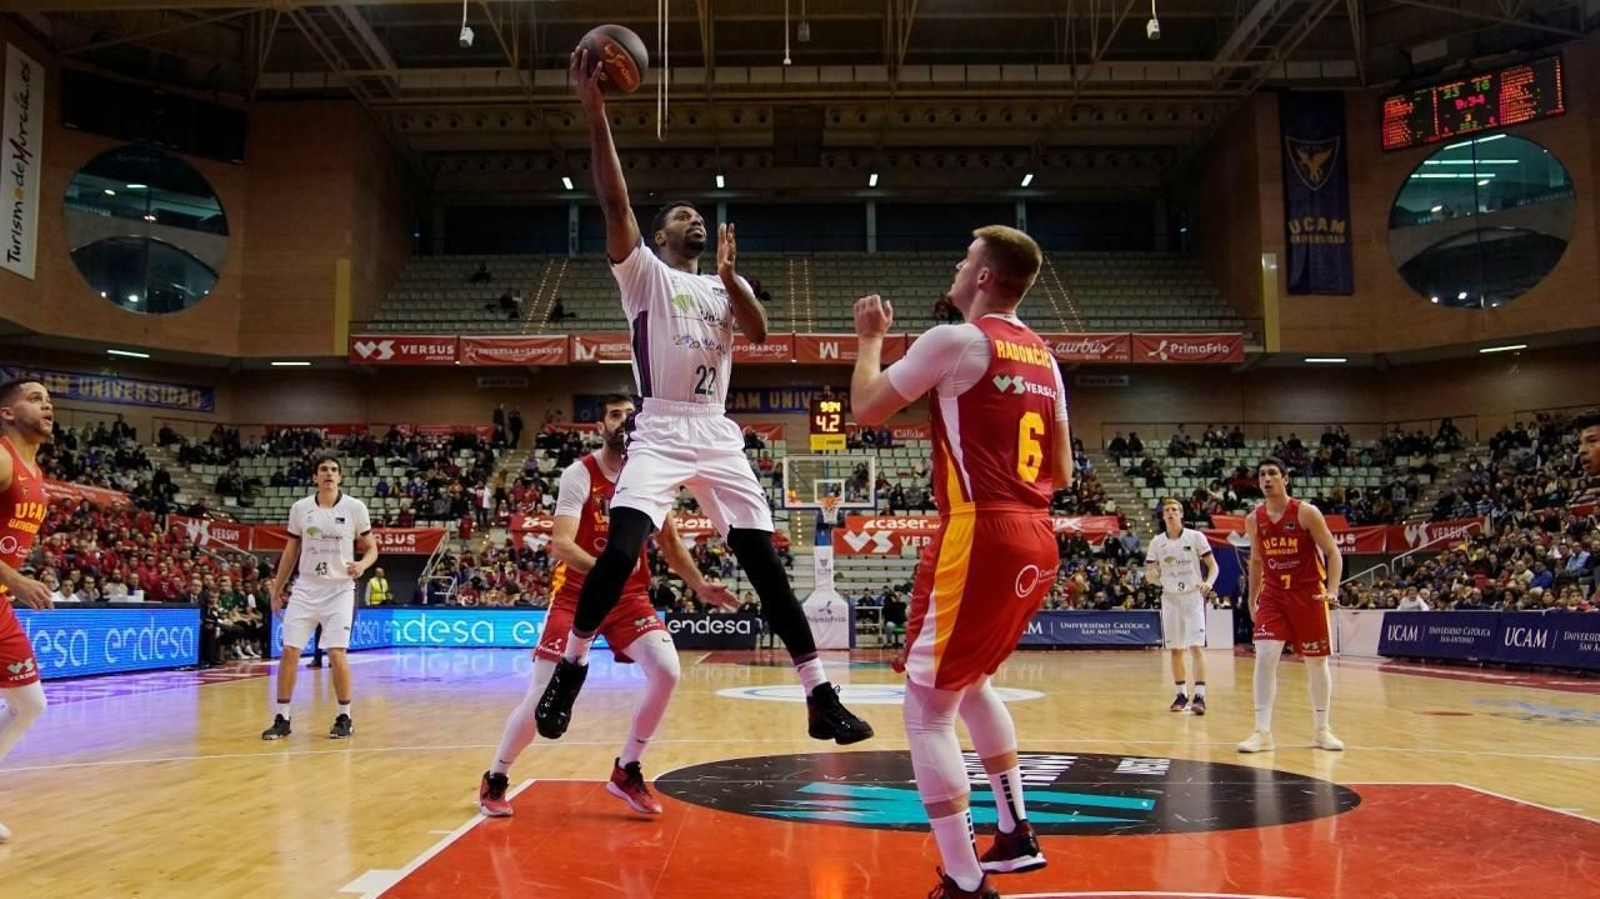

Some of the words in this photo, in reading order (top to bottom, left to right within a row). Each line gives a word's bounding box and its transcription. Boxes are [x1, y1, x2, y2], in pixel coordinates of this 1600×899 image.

[1289, 217, 1346, 234] UCAM
[400, 344, 455, 355] VERSUS
[1170, 342, 1230, 354] PrimaFrio
[695, 365, 716, 395] 22
[79, 379, 201, 406] UNIVERSIDAD
[815, 414, 840, 432] 4.2
[1017, 411, 1045, 483] 6
[876, 519, 928, 529] caser
[211, 528, 240, 541] VERSUS
[1263, 537, 1298, 549] UCAM
[315, 562, 328, 575] 43
[1177, 582, 1186, 592] 9
[1280, 574, 1292, 590] 7
[667, 616, 750, 634] endesa
[1060, 622, 1111, 630] UNIVERSIDAD
[1387, 625, 1418, 641] UCAM
[105, 616, 194, 664] endesa
[1504, 627, 1548, 648] UCAM
